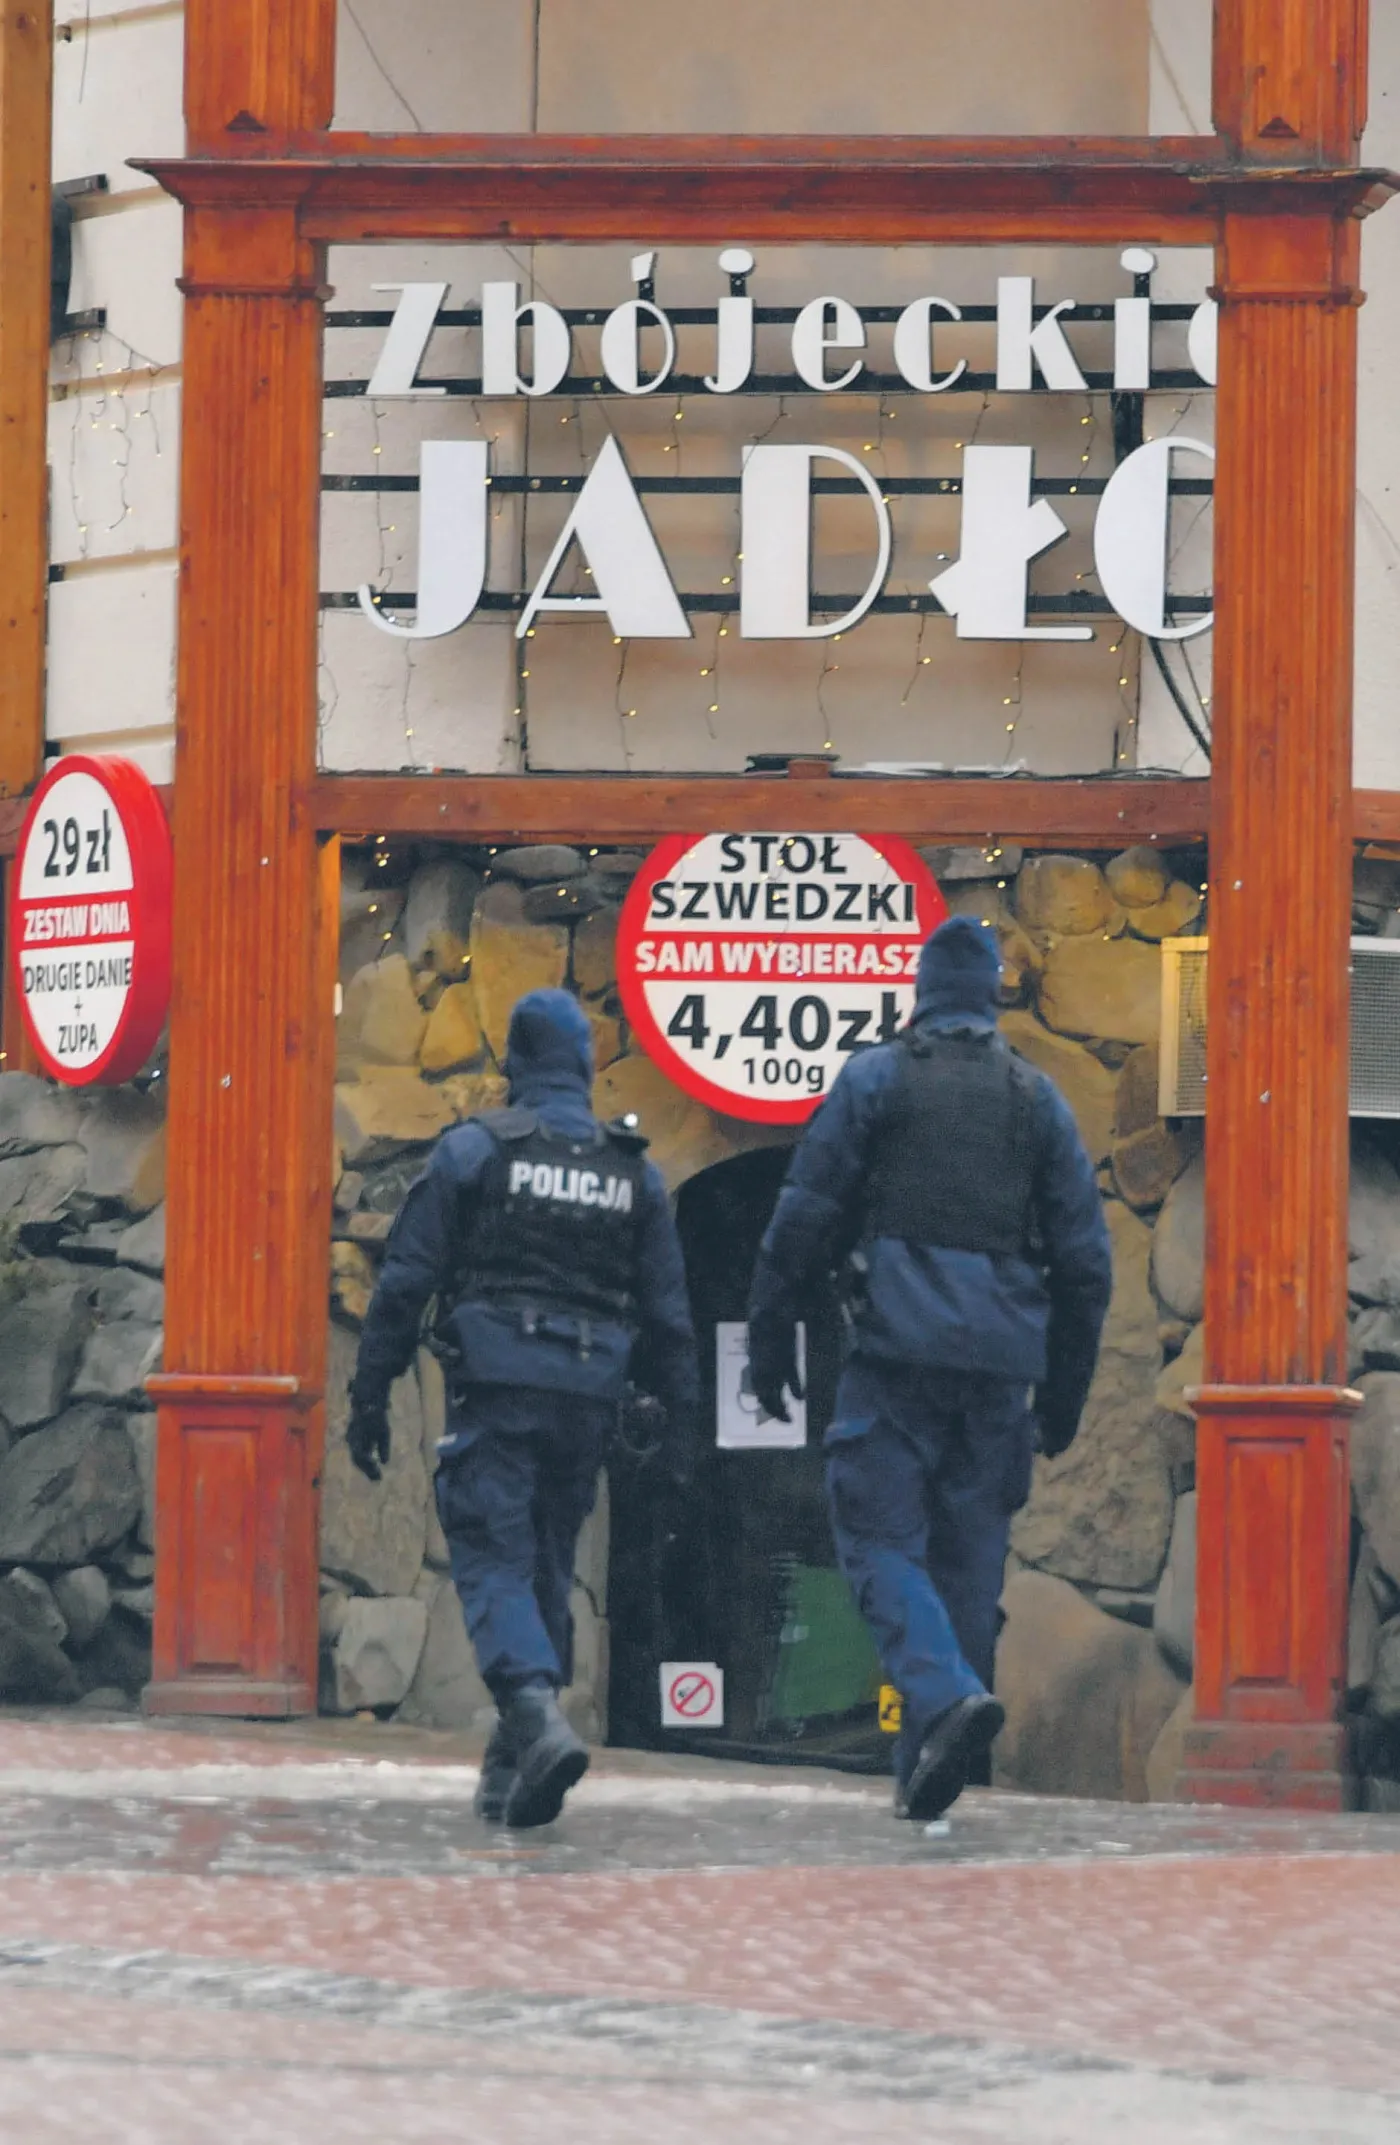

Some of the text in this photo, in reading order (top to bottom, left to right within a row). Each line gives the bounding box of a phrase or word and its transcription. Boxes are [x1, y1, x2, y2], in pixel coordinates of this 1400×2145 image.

[650, 881, 915, 922] SZWEDZKI
[23, 900, 130, 942] ZESTAW DNIA
[24, 957, 132, 995] DRUGIE DANIE
[635, 942, 924, 976] SAM WYBIERASZ
[57, 1022, 98, 1054] ZUPA
[742, 1059, 825, 1093] 100g
[509, 1160, 633, 1213] POLICJA
